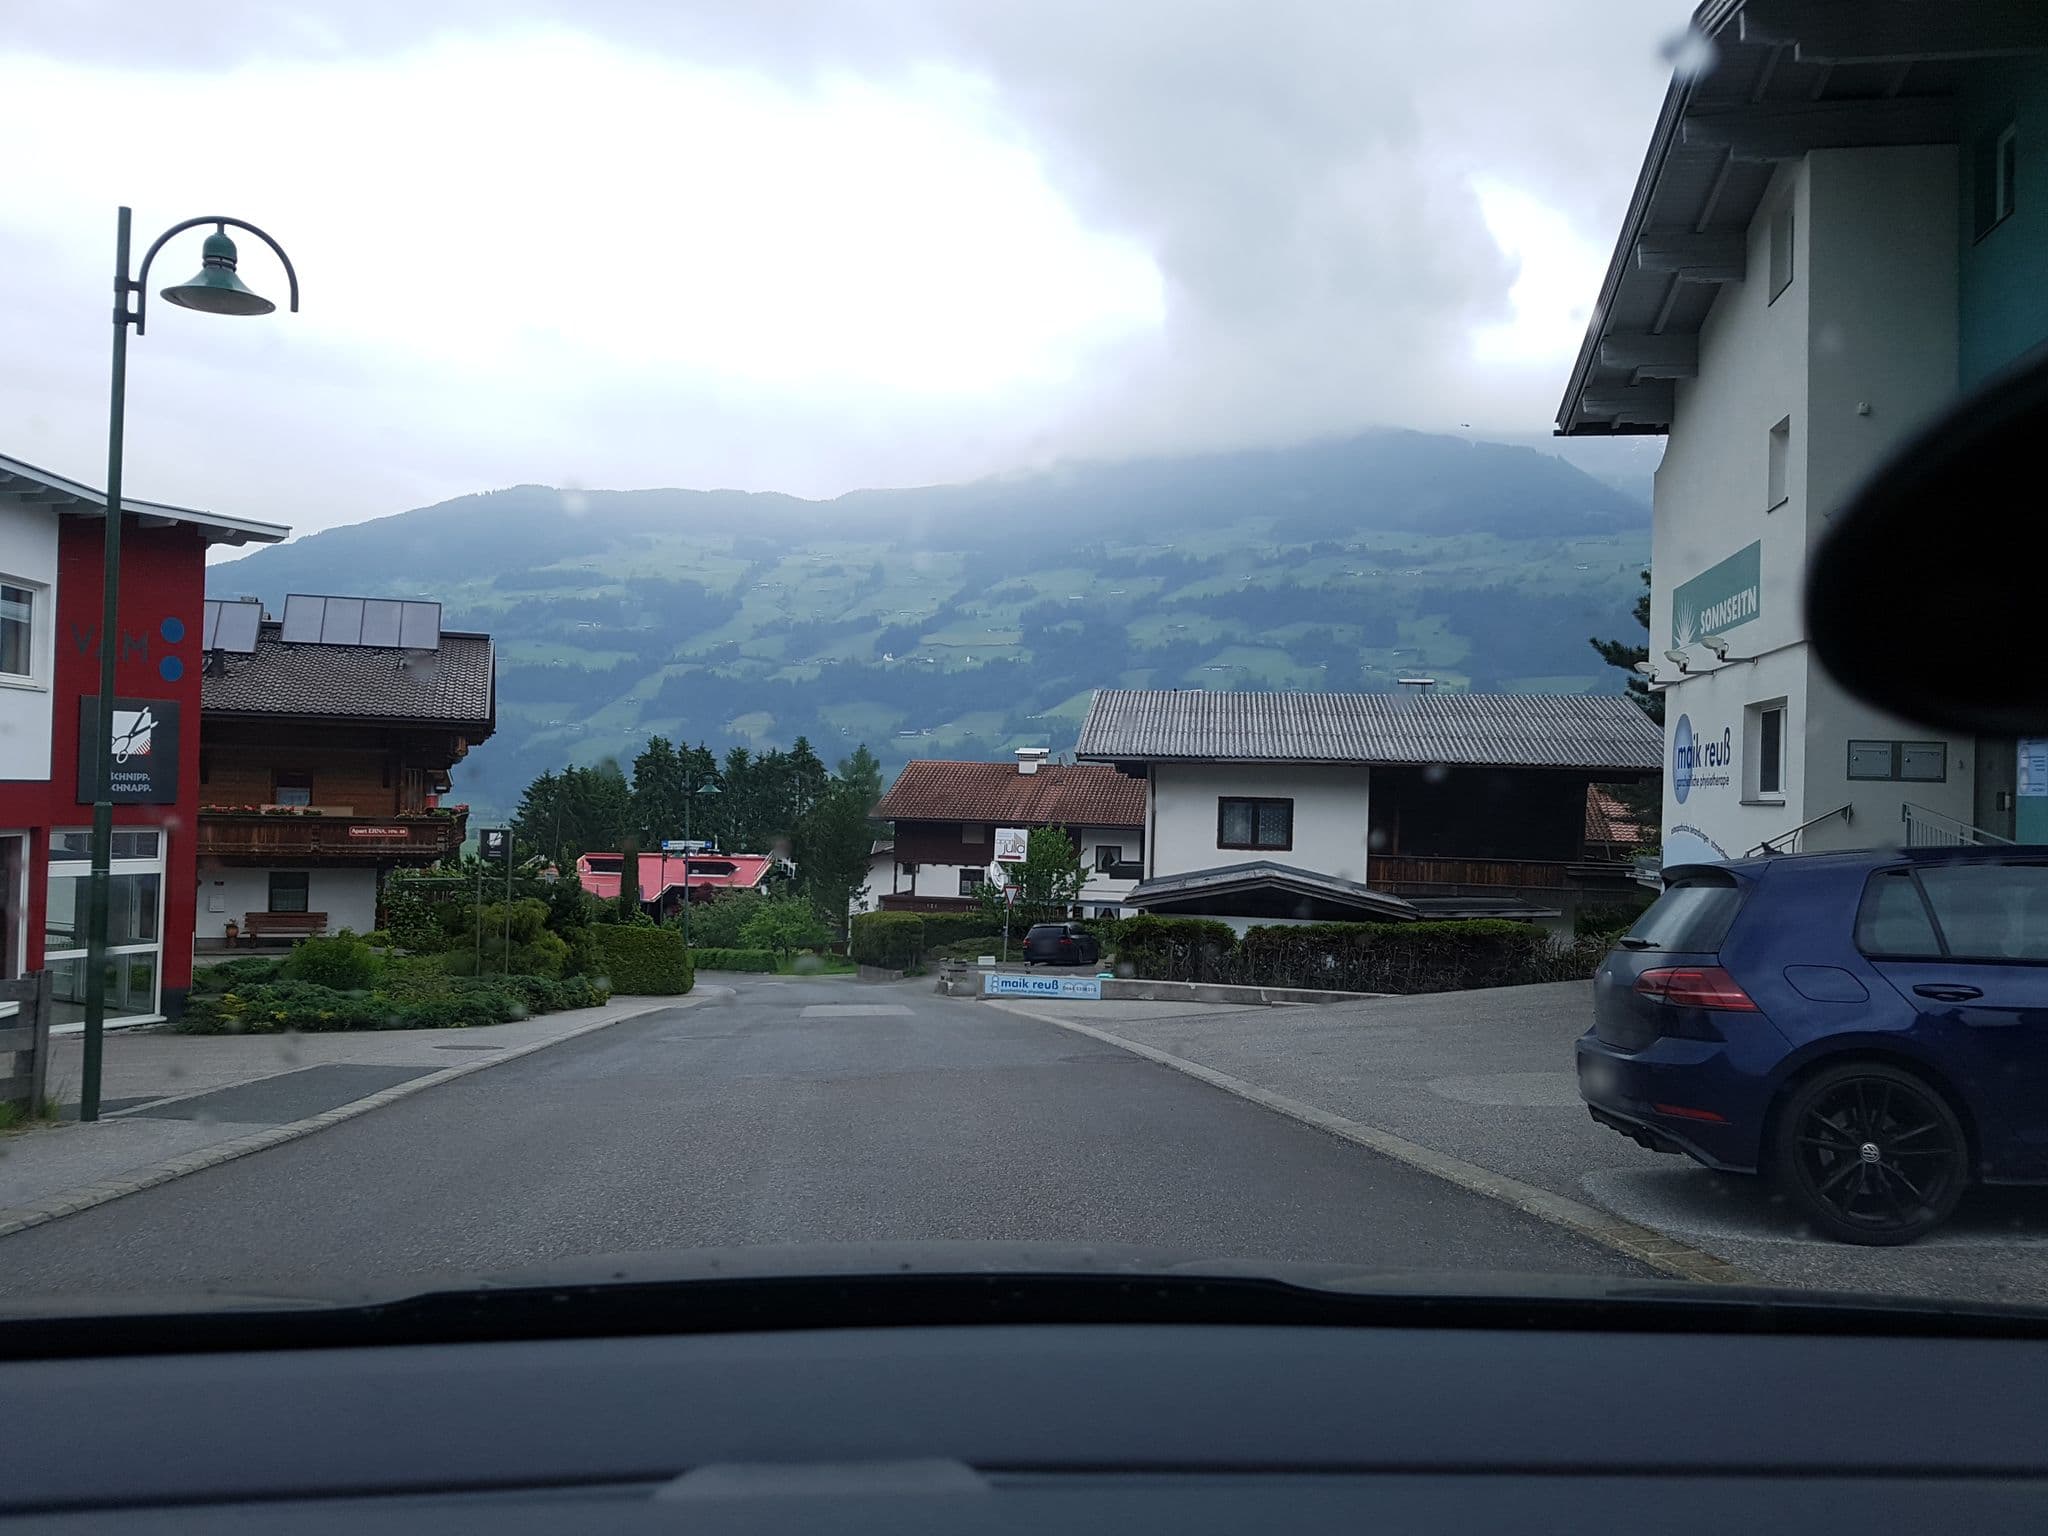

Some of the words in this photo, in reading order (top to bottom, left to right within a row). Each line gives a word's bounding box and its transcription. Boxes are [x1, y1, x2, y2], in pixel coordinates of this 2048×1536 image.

[1677, 733, 1702, 769] maik
[1705, 727, 1731, 767] reuß
[111, 783, 152, 792] CHNAPP.
[1001, 978, 1029, 988] maik
[1032, 980, 1059, 990] reuß
